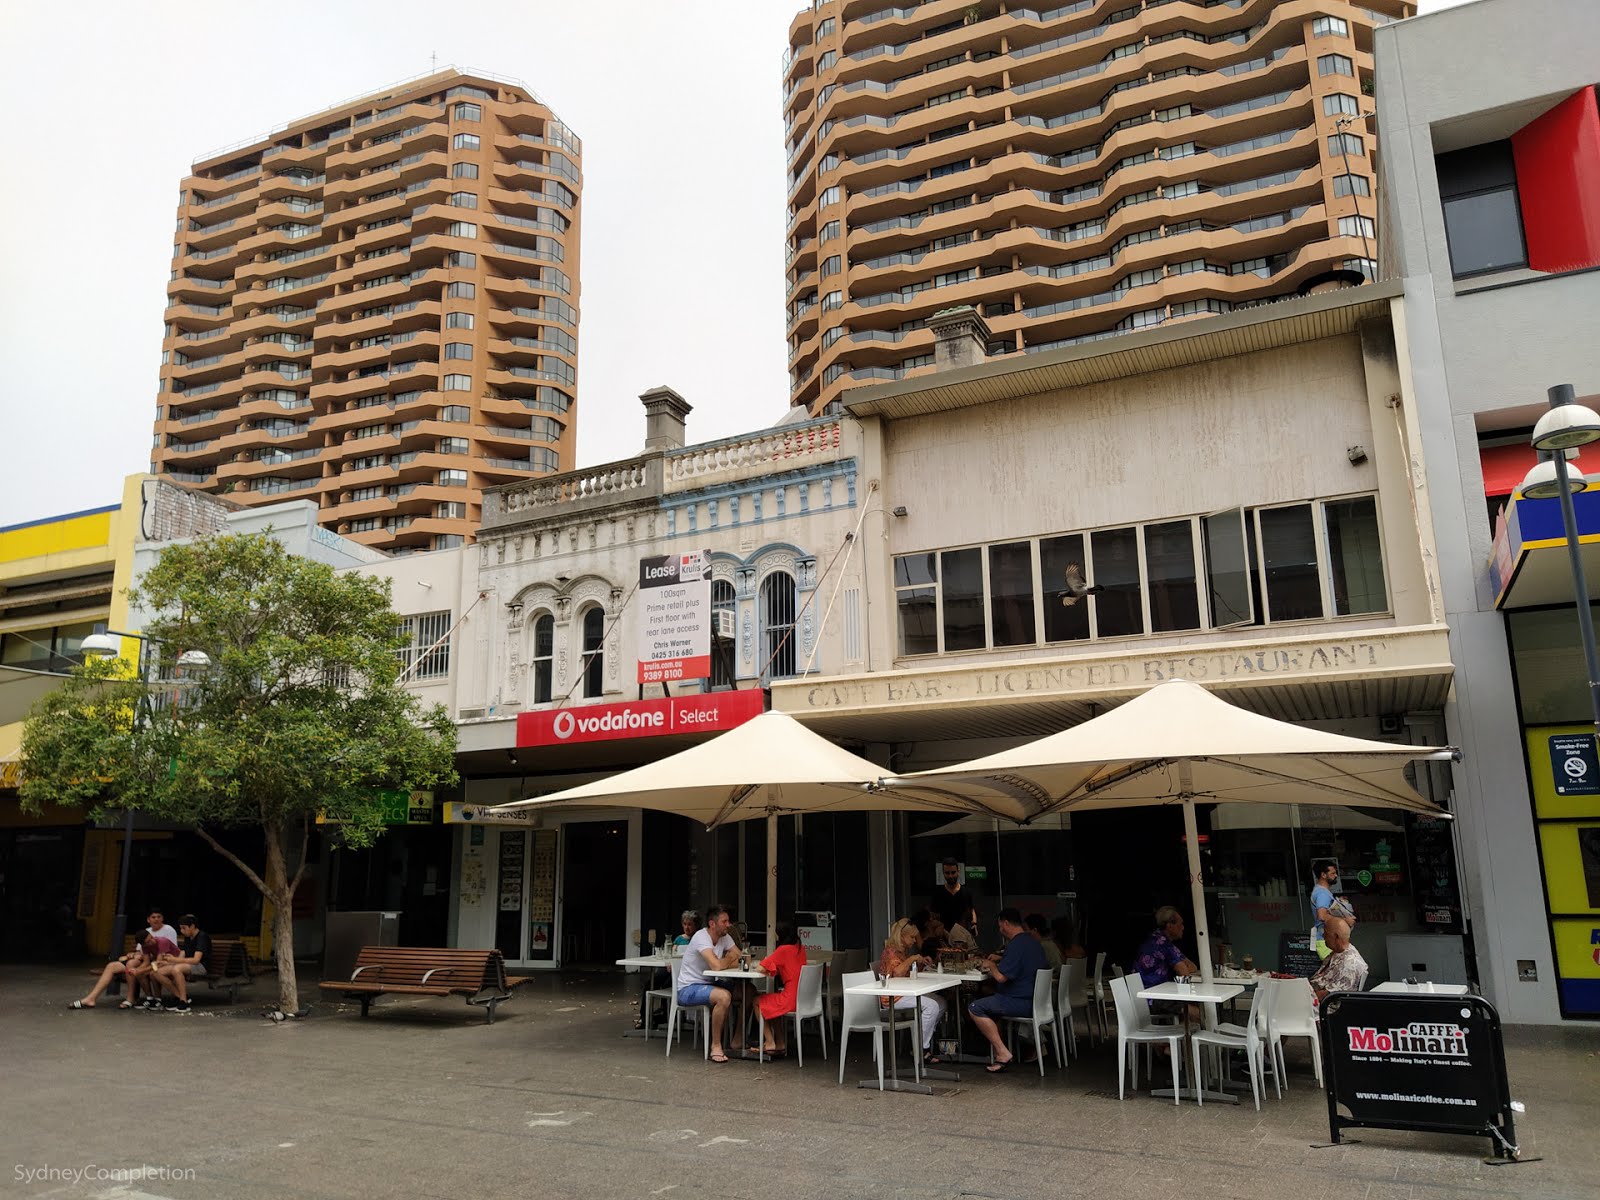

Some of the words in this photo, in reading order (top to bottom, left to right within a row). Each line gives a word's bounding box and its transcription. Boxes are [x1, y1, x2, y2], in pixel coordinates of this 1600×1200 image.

[645, 565, 675, 579] Lease
[681, 564, 701, 574] Krulis
[660, 588, 686, 599] 100sqm
[646, 601, 665, 613] Prime
[666, 599, 684, 610] retail
[685, 598, 700, 608] plus
[649, 615, 664, 625] First
[665, 613, 681, 623] floor
[681, 611, 696, 621] with
[646, 629, 659, 638] rear
[660, 626, 675, 635] lane
[676, 623, 700, 634] access
[653, 640, 669, 649] Chris
[651, 651, 667, 660] 0425
[668, 649, 680, 658] 316
[681, 648, 694, 657] 680
[643, 661, 683, 672] krulis.com.au
[975, 664, 1130, 695] LICENSED
[1143, 644, 1387, 681] RESTAURANT
[643, 671, 663, 681] 9389
[664, 668, 683, 679] 8100
[578, 709, 665, 733] vodafone
[679, 708, 720, 725] Select
[1348, 1028, 1467, 1055] Molinari
[1390, 1057, 1412, 1065] Making
[1356, 1092, 1477, 1106] www.molinaricoffee.com.au
